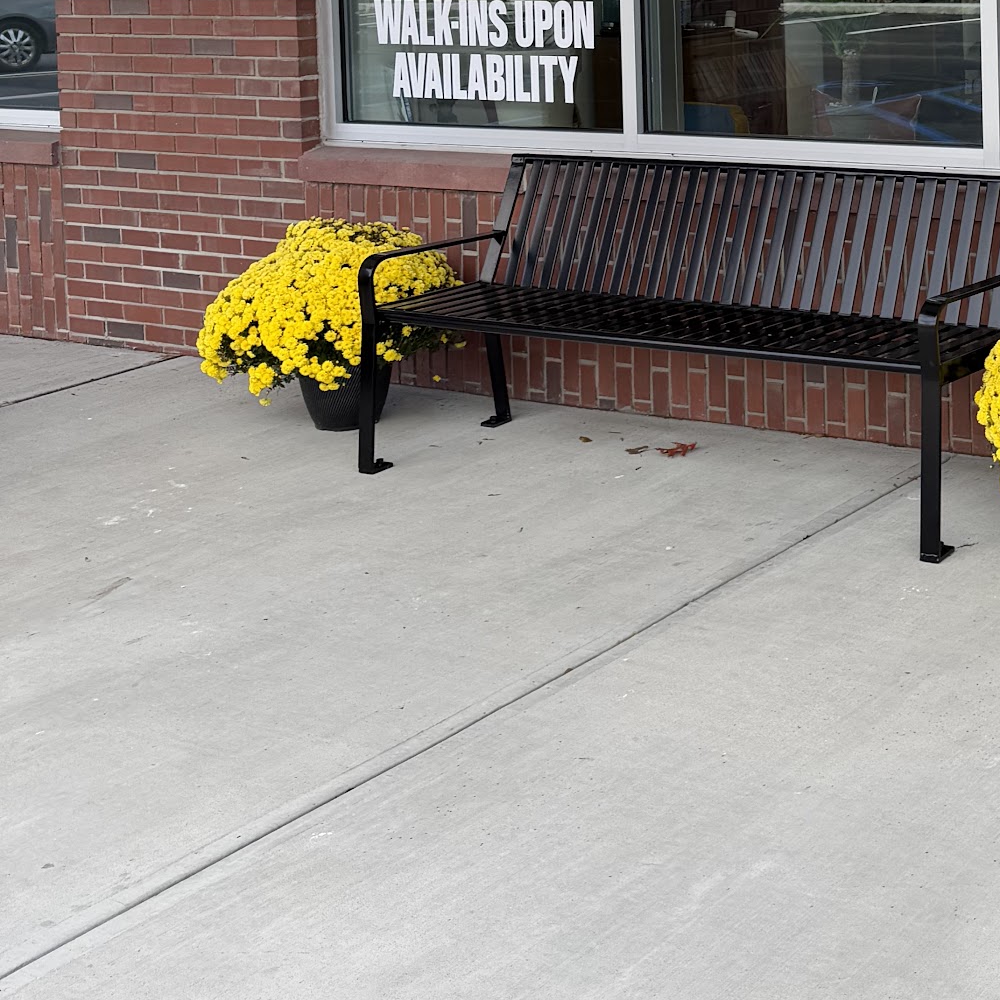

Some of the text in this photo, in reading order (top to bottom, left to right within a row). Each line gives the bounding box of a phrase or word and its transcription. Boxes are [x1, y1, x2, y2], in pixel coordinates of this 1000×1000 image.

[374, 0, 595, 49] WALK-INS UPON
[393, 52, 578, 104] AVAILABILITY
